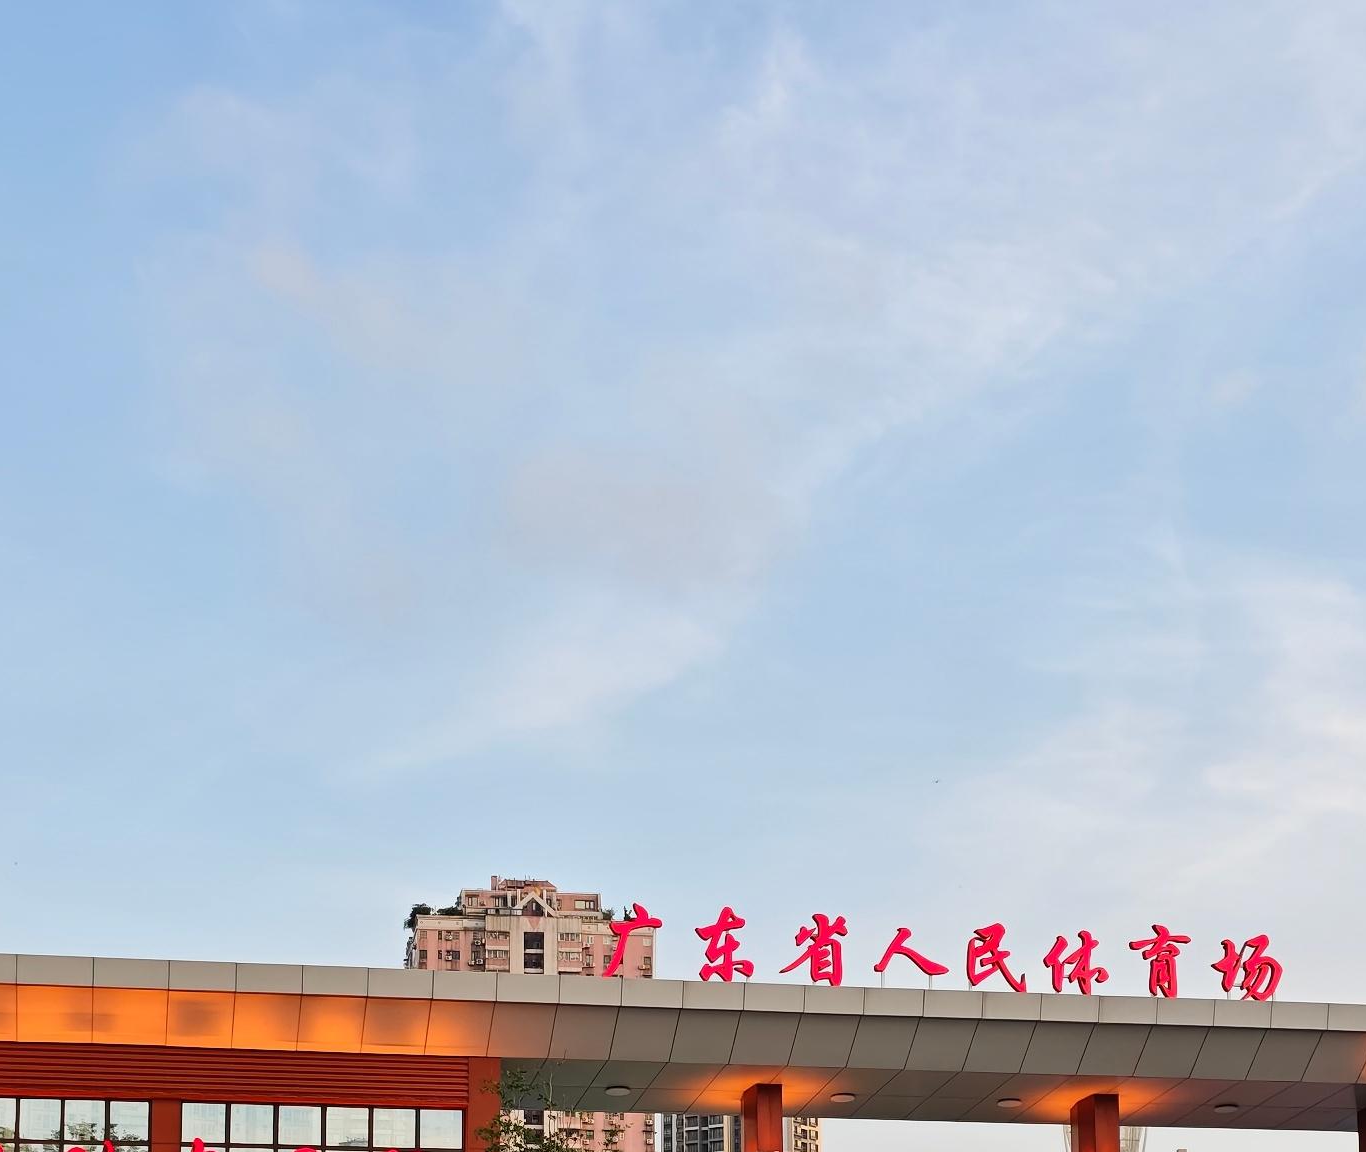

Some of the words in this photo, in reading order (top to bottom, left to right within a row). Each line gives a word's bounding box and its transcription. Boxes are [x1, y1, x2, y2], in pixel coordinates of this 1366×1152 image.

[602, 904, 1284, 1000] 广东省人民体育场
